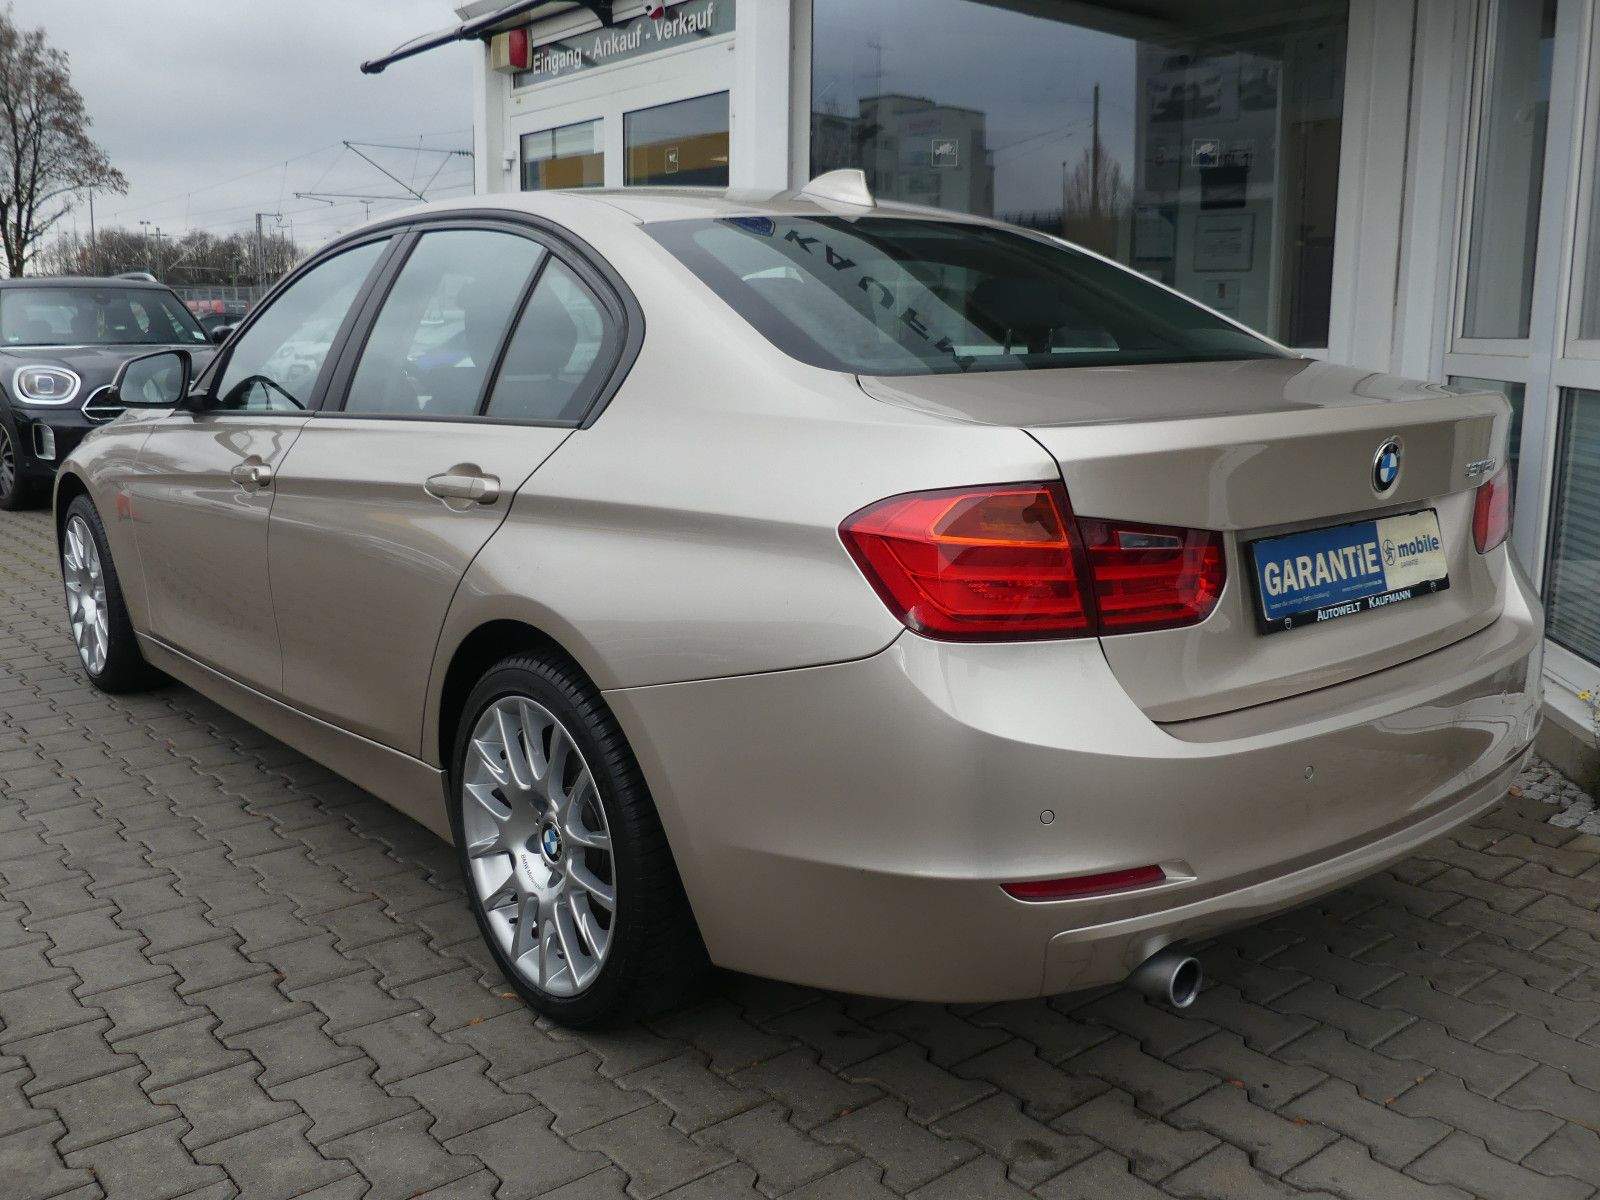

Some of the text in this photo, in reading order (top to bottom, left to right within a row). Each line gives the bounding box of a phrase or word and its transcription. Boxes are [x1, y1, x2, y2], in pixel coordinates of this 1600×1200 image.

[533, 47, 582, 75] Eingang
[593, 23, 642, 60] Ankauf
[654, 2, 713, 41] Verkauf
[1397, 533, 1440, 558] mobile
[1317, 589, 1412, 621] AUTOWELT KAUFMANN
